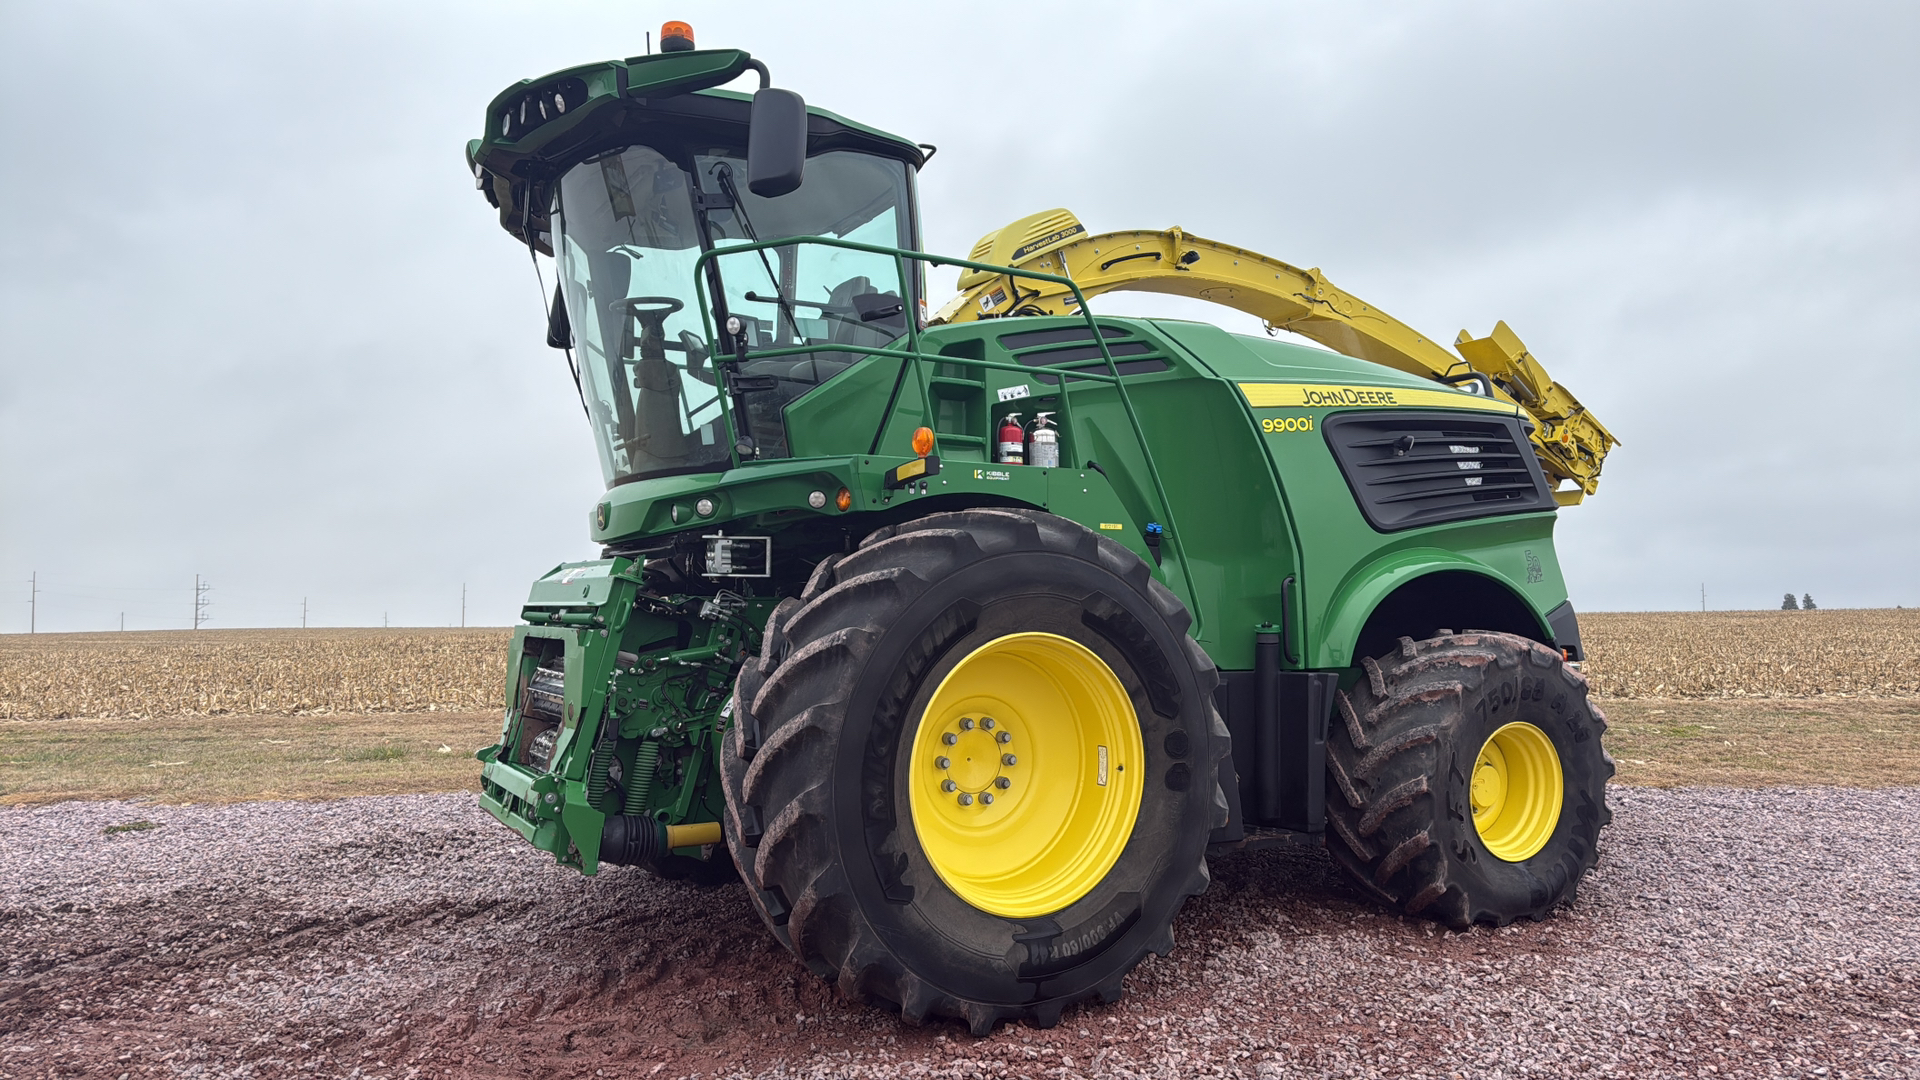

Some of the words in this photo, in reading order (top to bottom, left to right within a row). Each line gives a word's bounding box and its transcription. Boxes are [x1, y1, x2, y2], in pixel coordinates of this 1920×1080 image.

[1023, 234, 1060, 254] HarvestLab
[1060, 227, 1077, 239] 3000
[1302, 388, 1344, 405] JOHN
[1343, 388, 1398, 405] DEERE
[1261, 415, 1314, 433] 9900i
